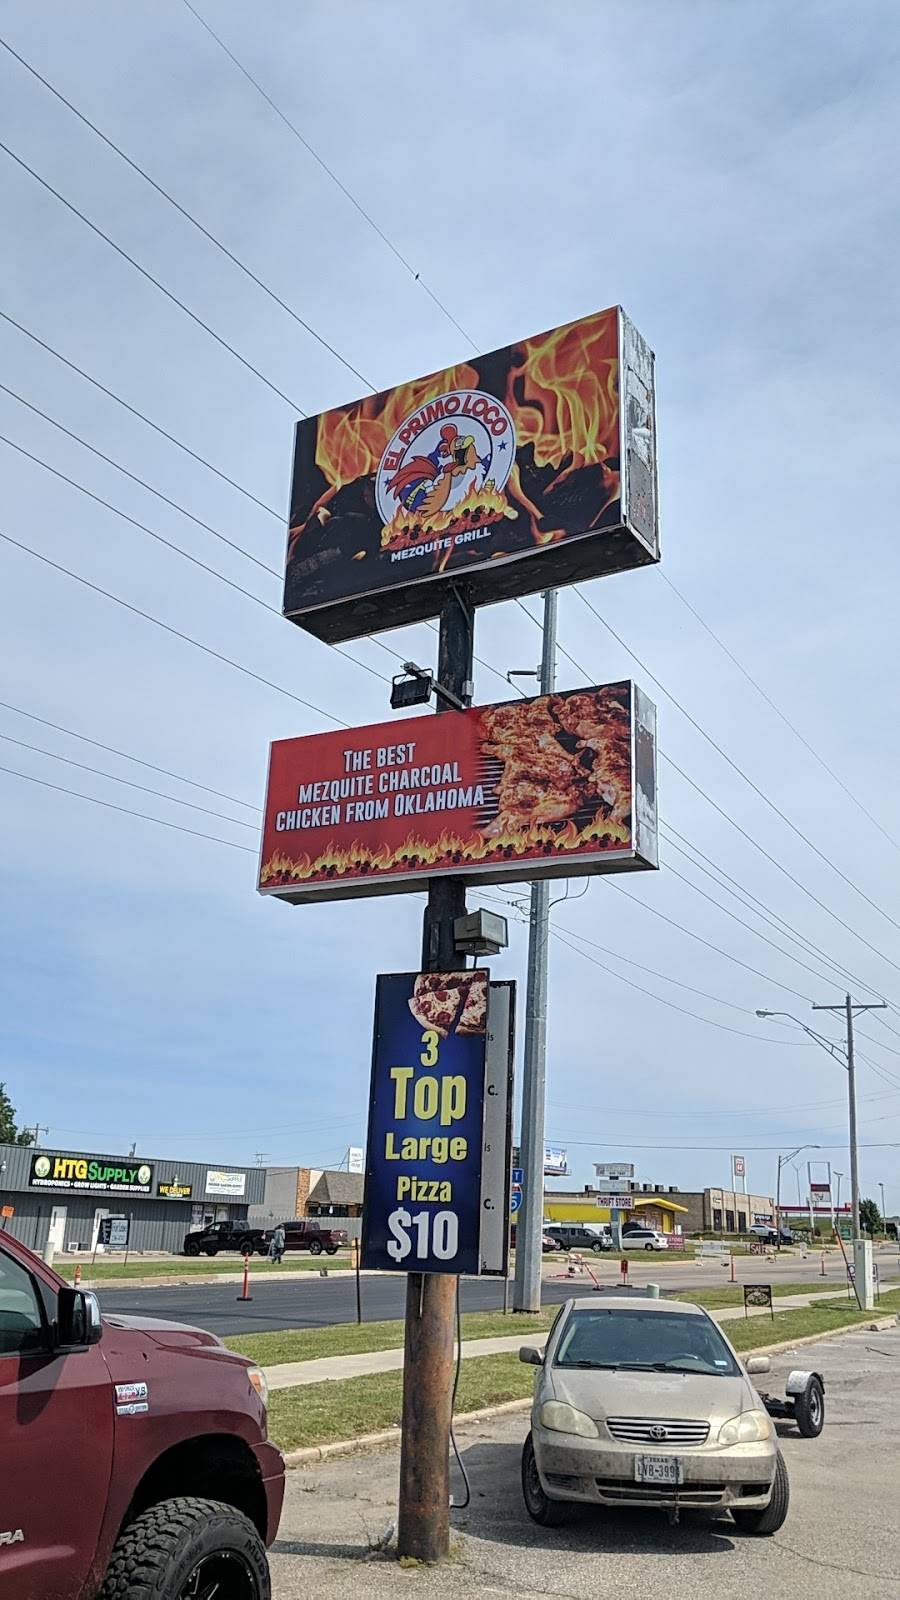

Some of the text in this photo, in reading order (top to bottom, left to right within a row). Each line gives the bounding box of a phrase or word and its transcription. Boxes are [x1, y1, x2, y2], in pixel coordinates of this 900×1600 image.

[383, 394, 508, 471] EL PRIMO LOCO
[391, 527, 491, 562] MEZQUITE GRILL
[344, 743, 416, 773] THE BEST
[298, 762, 463, 804] MEZQUITE CHARCOAL
[275, 785, 485, 832] CHICKEN FROM OKLAHOMA
[420, 1030, 439, 1067] 3
[390, 1067, 467, 1126] Top
[385, 1132, 468, 1164] Large
[53, 1158, 88, 1180] HTG
[397, 1176, 452, 1202] Pizza
[597, 1197, 631, 1207] THRIFT STORE
[387, 1206, 459, 1263] $10
